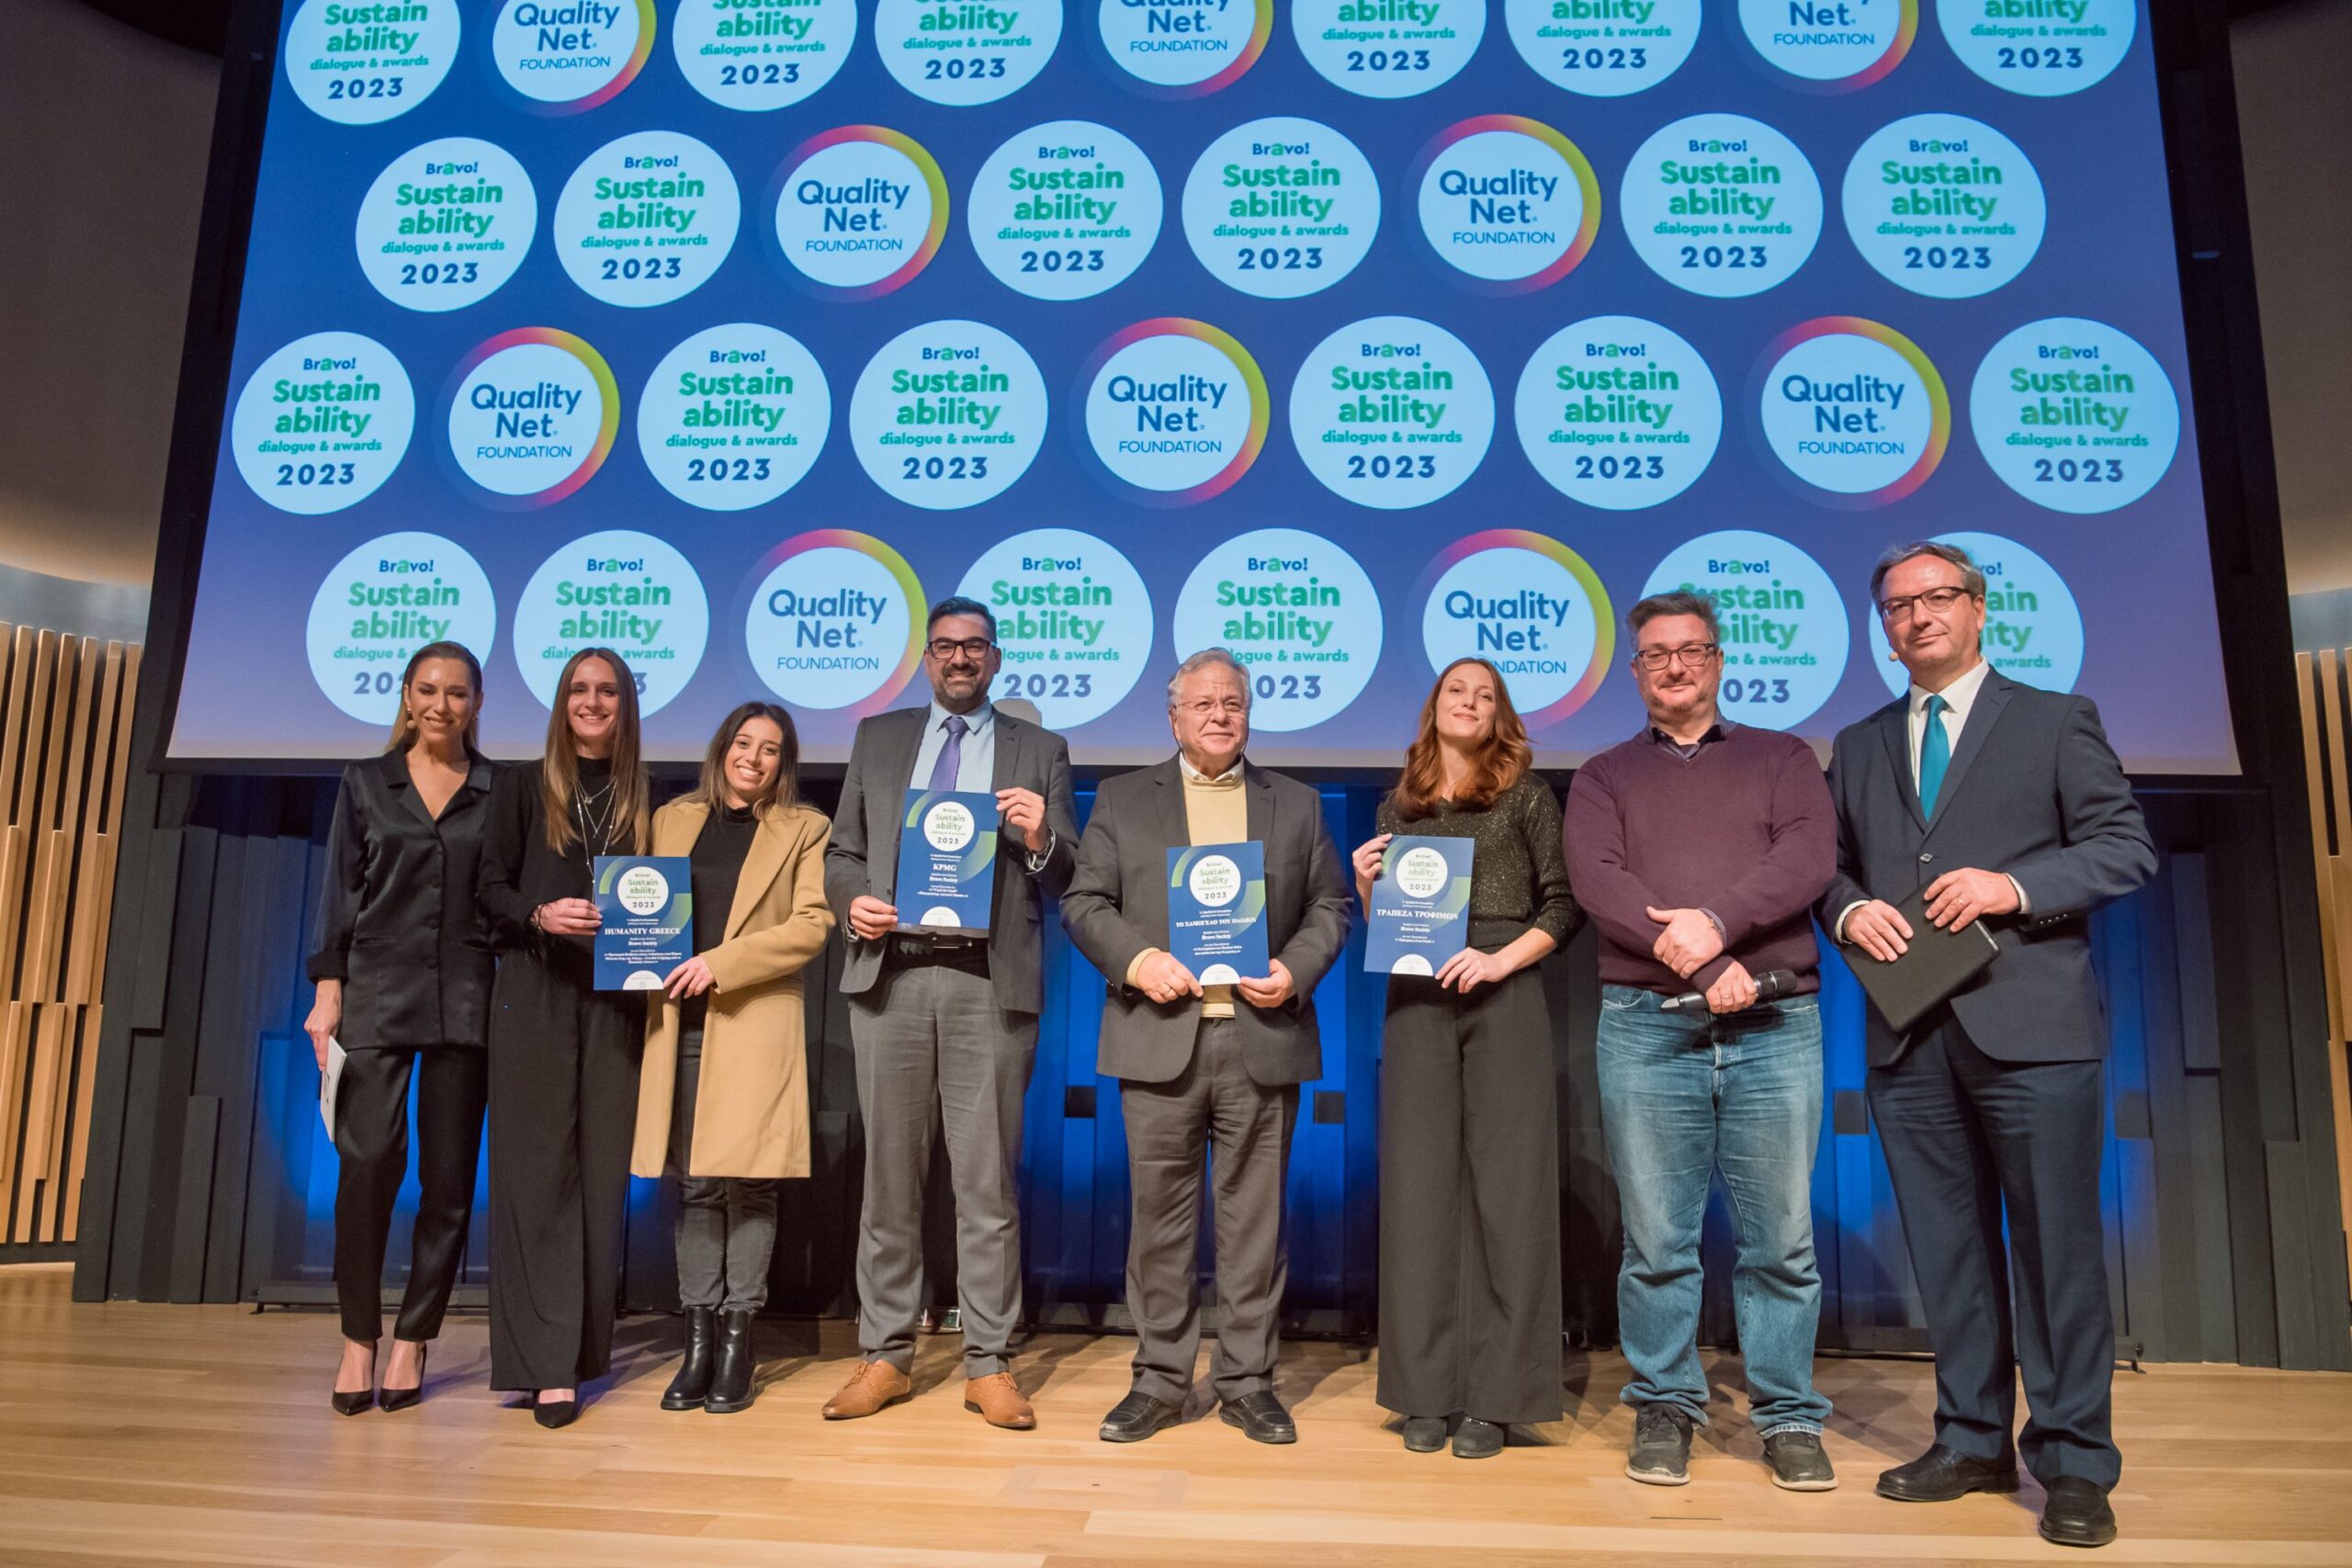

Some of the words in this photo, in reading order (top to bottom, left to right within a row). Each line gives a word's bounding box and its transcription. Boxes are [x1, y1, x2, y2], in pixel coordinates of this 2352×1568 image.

[323, 0, 428, 27] Sustain
[514, 0, 620, 29] Quality
[919, 4, 1020, 35] ability
[1338, 0, 1441, 28] ability
[1552, 0, 1656, 25] ability
[1984, 0, 2087, 23] ability
[716, 10, 814, 40] ability
[1536, 25, 1600, 40] dialogue
[1603, 26, 1614, 37] &
[1618, 24, 1672, 38] awards
[325, 26, 420, 55] ability
[1130, 39, 1227, 52] FOUNDATION
[1773, 33, 1875, 45] FOUNDATION
[309, 58, 367, 72] dialogue
[368, 57, 379, 68] &
[381, 54, 429, 68] awards
[519, 56, 611, 71] FOUNDATION
[924, 57, 1006, 80] 2023
[1347, 50, 1430, 72] 2023
[1563, 48, 1646, 69] 2023
[1997, 47, 2084, 69] 2023
[720, 62, 800, 85] 2023
[327, 77, 403, 99] 2023
[1038, 145, 1095, 160] Bravo!
[1252, 142, 1310, 156] Bravo!
[1689, 140, 1747, 153] Bravo!
[1908, 139, 1969, 154] Bravo!
[425, 162, 479, 176] Bravo!
[624, 155, 679, 170] Bravo!
[1222, 159, 1341, 187] Sustain
[1660, 156, 1781, 185] Sustain
[1882, 156, 2003, 186] Sustain
[594, 171, 706, 200] Sustain
[1008, 162, 1125, 191] Sustain
[1439, 168, 1558, 202] Quality
[395, 177, 503, 207] Sustain
[797, 177, 910, 209] Quality
[1013, 192, 1117, 226] ability
[1228, 189, 1334, 223] ability
[1668, 187, 1776, 221] ability
[1891, 187, 1998, 223] ability
[397, 207, 494, 239] ability
[597, 201, 696, 233] ability
[1653, 220, 1719, 237] dialogue
[1722, 222, 1734, 235] &
[1737, 221, 1793, 235] awards
[581, 235, 640, 250] dialogue
[643, 235, 654, 247] &
[658, 233, 709, 246] awards
[805, 239, 903, 252] FOUNDATION
[1453, 231, 1555, 244] FOUNDATION
[1021, 249, 1104, 272] 2023
[1238, 247, 1323, 270] 2023
[1680, 245, 1768, 268] 2023
[1904, 246, 1992, 269] 2023
[400, 262, 479, 286] 2023
[601, 257, 682, 280] 2023
[709, 349, 765, 364] Bravo!
[922, 346, 979, 361] Bravo!
[1361, 344, 1421, 358] Bravo!
[1586, 343, 1646, 358] Bravo!
[2038, 345, 2099, 360] Bravo!
[302, 357, 356, 372] Bravo!
[1330, 361, 1453, 391] Sustain
[1556, 361, 1679, 391] Sustain
[272, 373, 381, 404] Sustain
[678, 367, 794, 397] Sustain
[891, 364, 1010, 394] Sustain
[2009, 364, 2136, 394] Sustain
[470, 381, 582, 415] Quality
[1107, 373, 1227, 409] Quality
[1781, 374, 1905, 411] Quality
[274, 404, 372, 438] ability
[682, 398, 786, 434] ability
[896, 396, 1001, 431] ability
[1338, 393, 1447, 429] ability
[1564, 393, 1674, 430] ability
[2019, 396, 2131, 433] ability
[665, 434, 728, 449] dialogue
[730, 434, 741, 446] &
[745, 434, 798, 446] awards
[1118, 440, 1222, 453] FOUNDATION
[1547, 429, 1615, 446] dialogue
[1619, 431, 1630, 444] &
[1634, 430, 1690, 444] awards
[1798, 441, 1905, 455] FOUNDATION
[476, 445, 572, 458] FOUNDATION
[276, 463, 356, 486] 2023
[687, 457, 771, 481] 2023
[902, 457, 988, 479] 2023
[1348, 455, 1436, 479] 2023
[1575, 456, 1664, 479] 2023
[2034, 458, 2123, 482] 2023
[379, 558, 434, 574] Bravo!
[586, 558, 644, 573] Bravo!
[1022, 557, 1082, 572] Bravo!
[1248, 557, 1308, 573] Bravo!
[1708, 558, 1770, 575] Bravo!
[348, 577, 460, 607] Sustain
[555, 576, 672, 606] Sustain
[990, 575, 1113, 606] Sustain
[1216, 576, 1341, 607] Sustain
[768, 588, 888, 625] Quality
[1444, 589, 1571, 627] Quality
[350, 610, 451, 643] ability
[559, 610, 662, 645] ability
[997, 610, 1104, 646] ability
[1223, 610, 1334, 648] ability
[623, 647, 675, 660] awards
[777, 657, 878, 670] FOUNDATION
[1995, 654, 2052, 668] awards
[1495, 660, 1566, 673] NDATION
[1004, 674, 1091, 697] 2023
[1256, 675, 1321, 699] 023
[1723, 679, 1790, 703] 023
[933, 863, 956, 872] KPMG
[629, 886, 657, 896] ability
